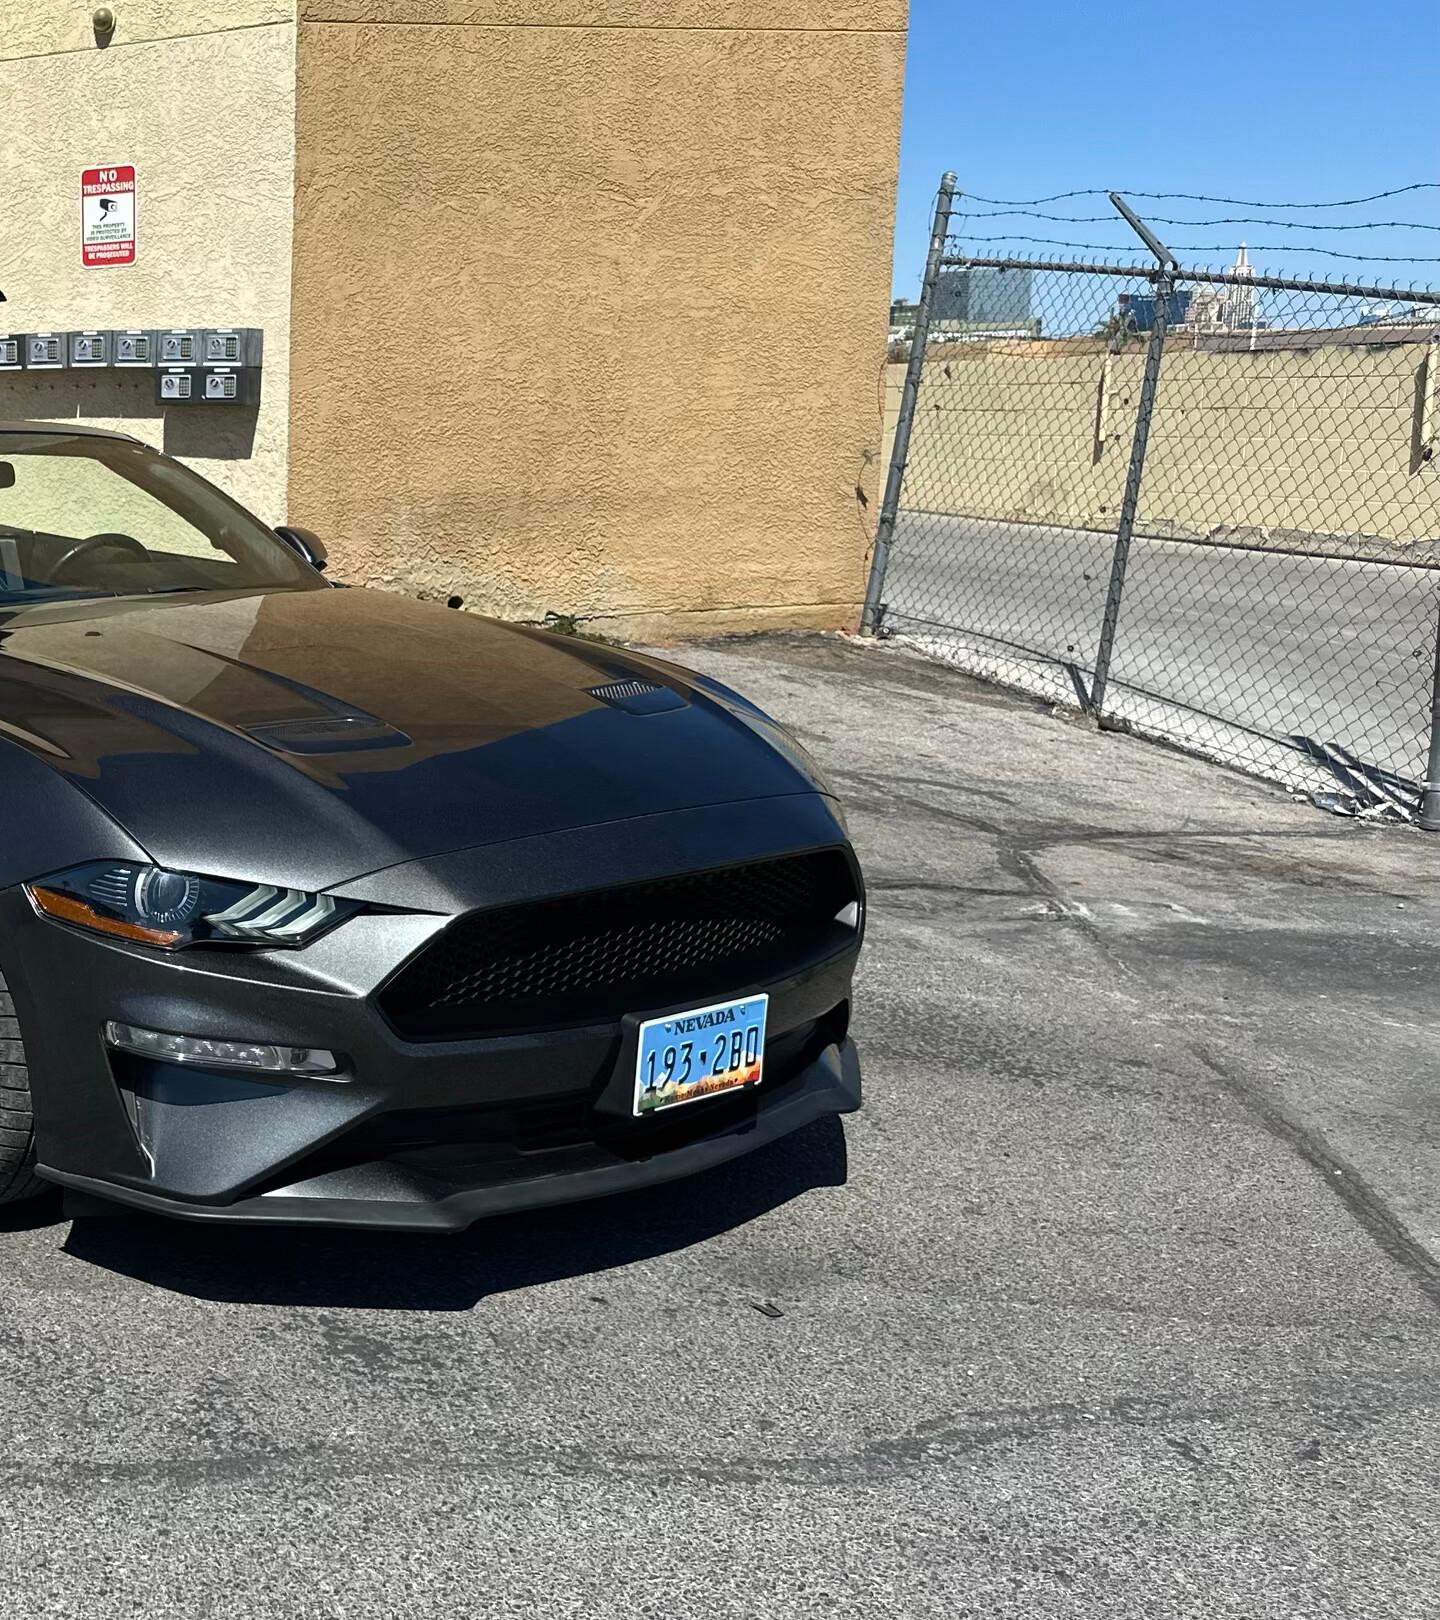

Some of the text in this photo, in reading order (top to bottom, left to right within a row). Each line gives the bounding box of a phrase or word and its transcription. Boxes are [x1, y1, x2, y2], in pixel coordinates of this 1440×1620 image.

[99, 170, 118, 183] NO
[83, 181, 134, 194] TRESPASSING
[674, 1008, 735, 1035] NEVADA
